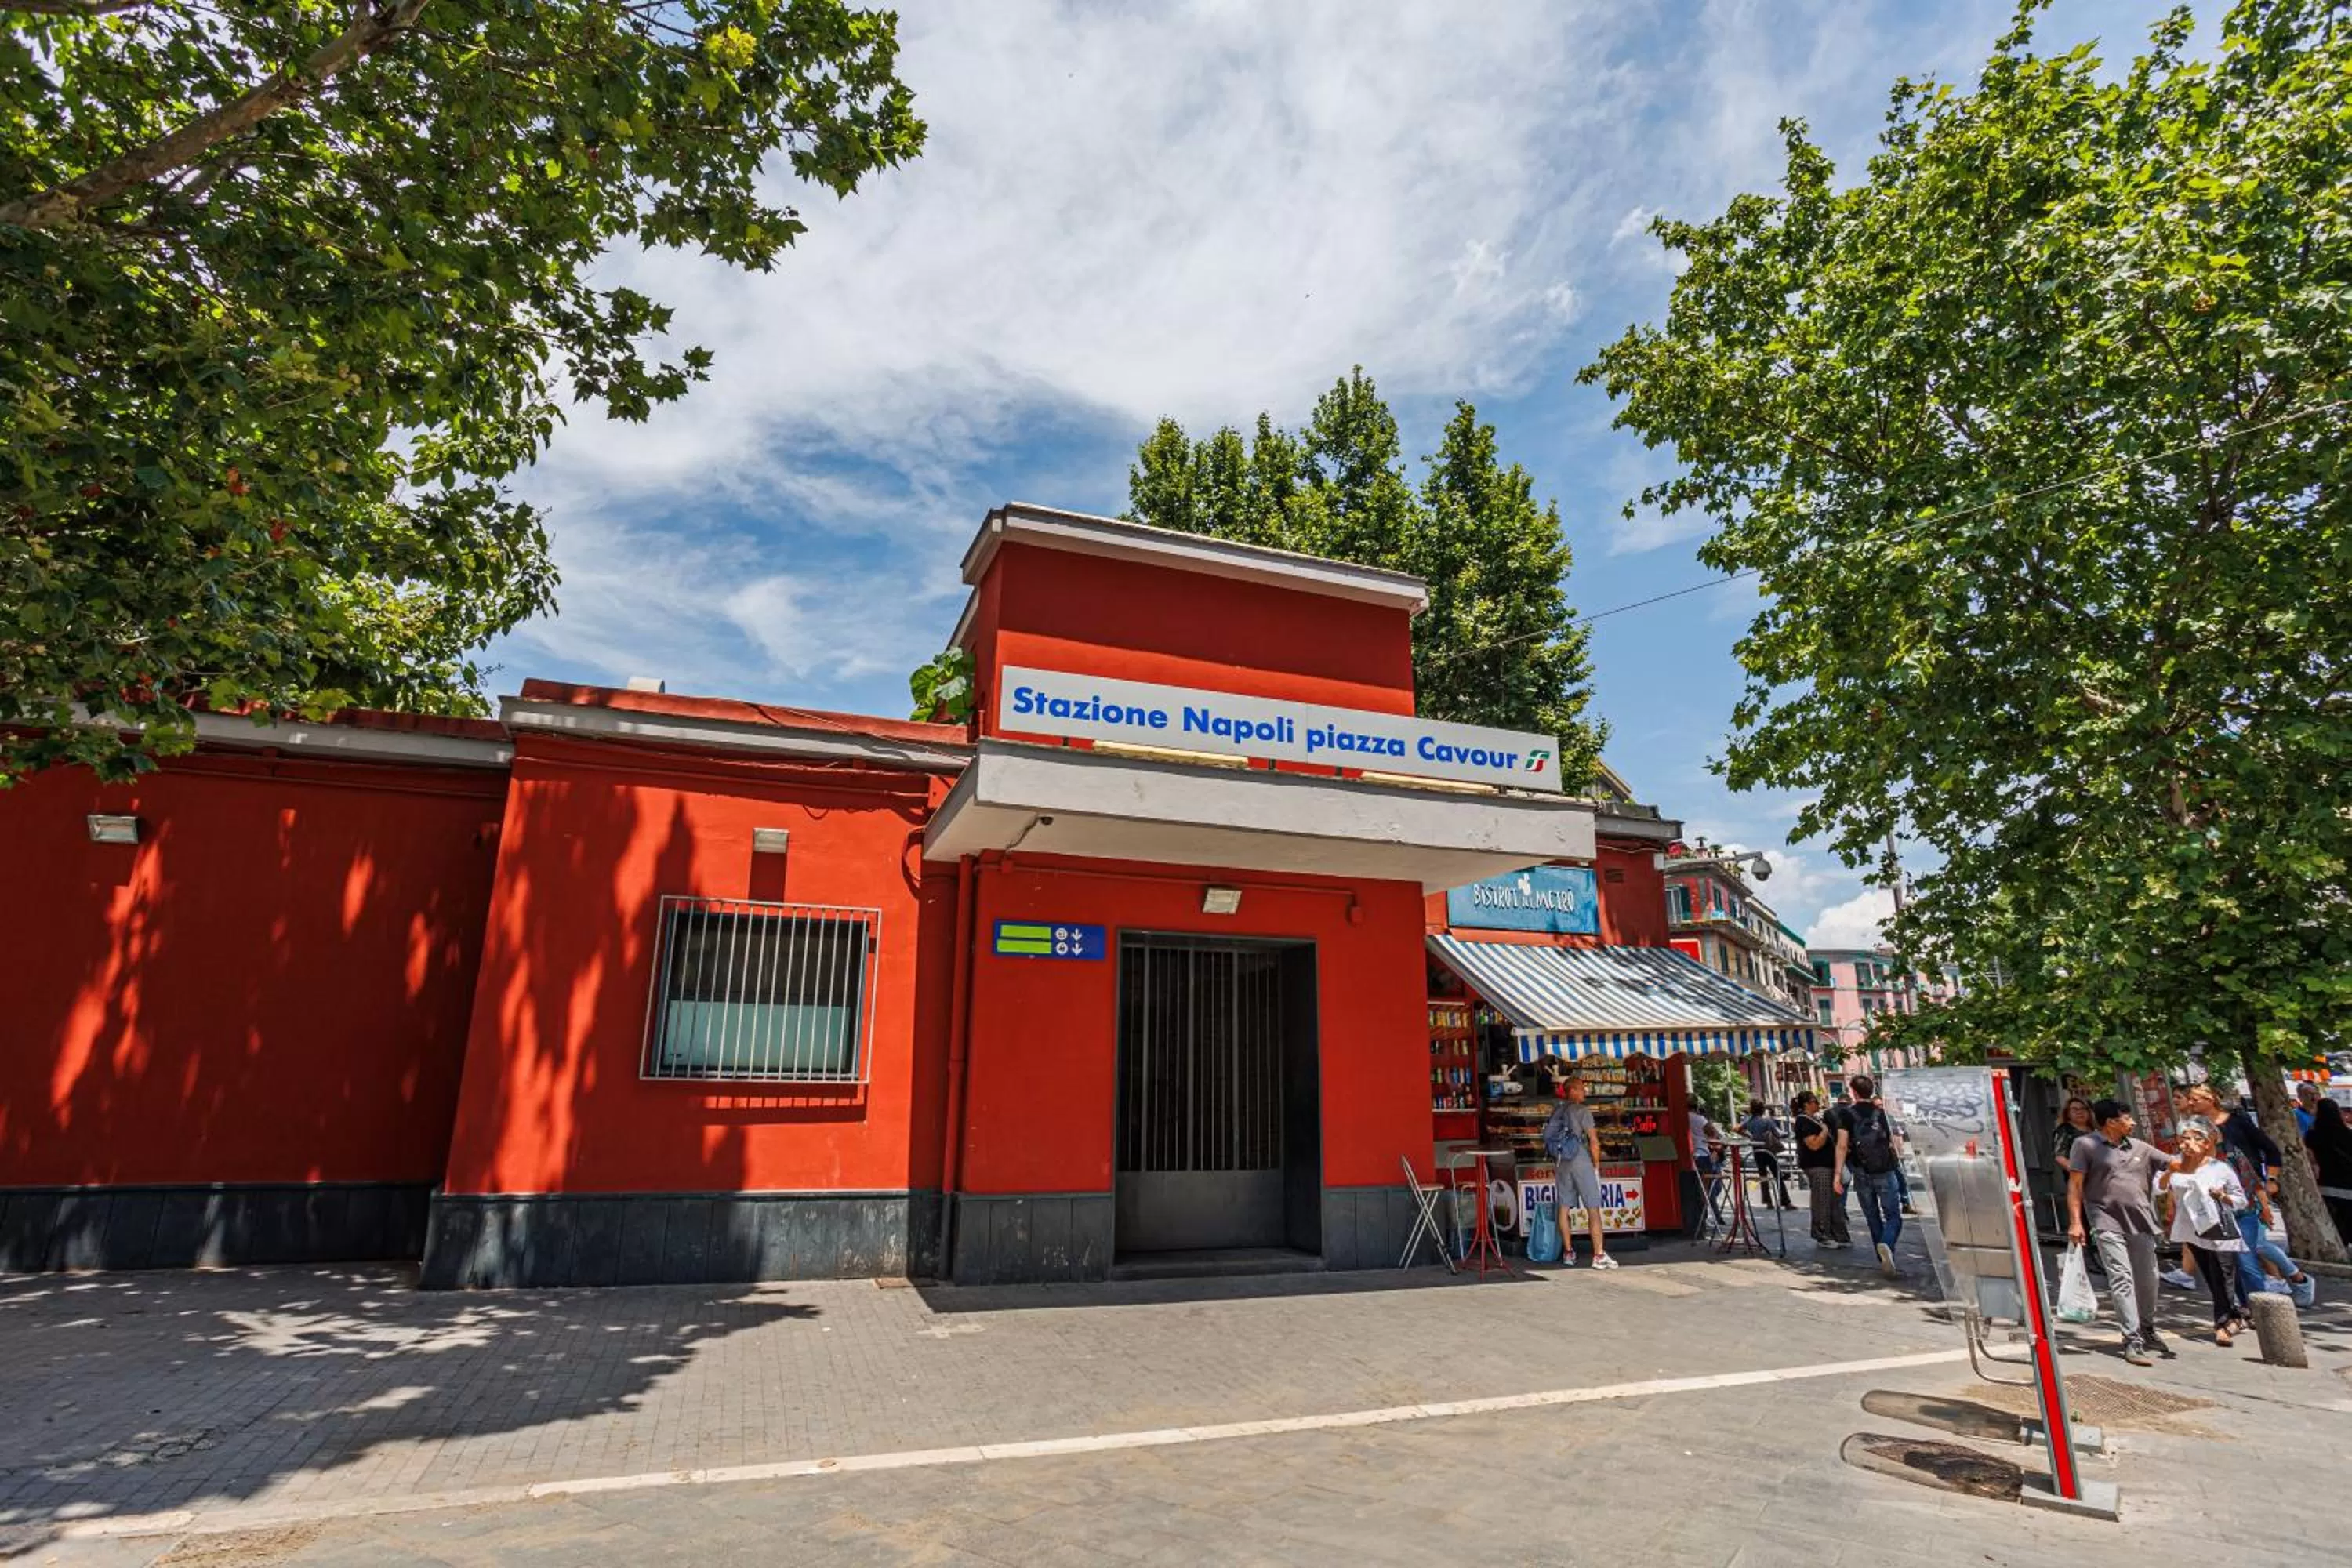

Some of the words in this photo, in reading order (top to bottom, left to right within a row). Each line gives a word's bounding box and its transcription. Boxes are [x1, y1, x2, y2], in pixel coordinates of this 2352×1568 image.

[1012, 686, 1168, 728] Stazione
[1182, 706, 1294, 743] Napoli
[1305, 724, 1406, 757] piazza
[1416, 735, 1519, 769] Cavour
